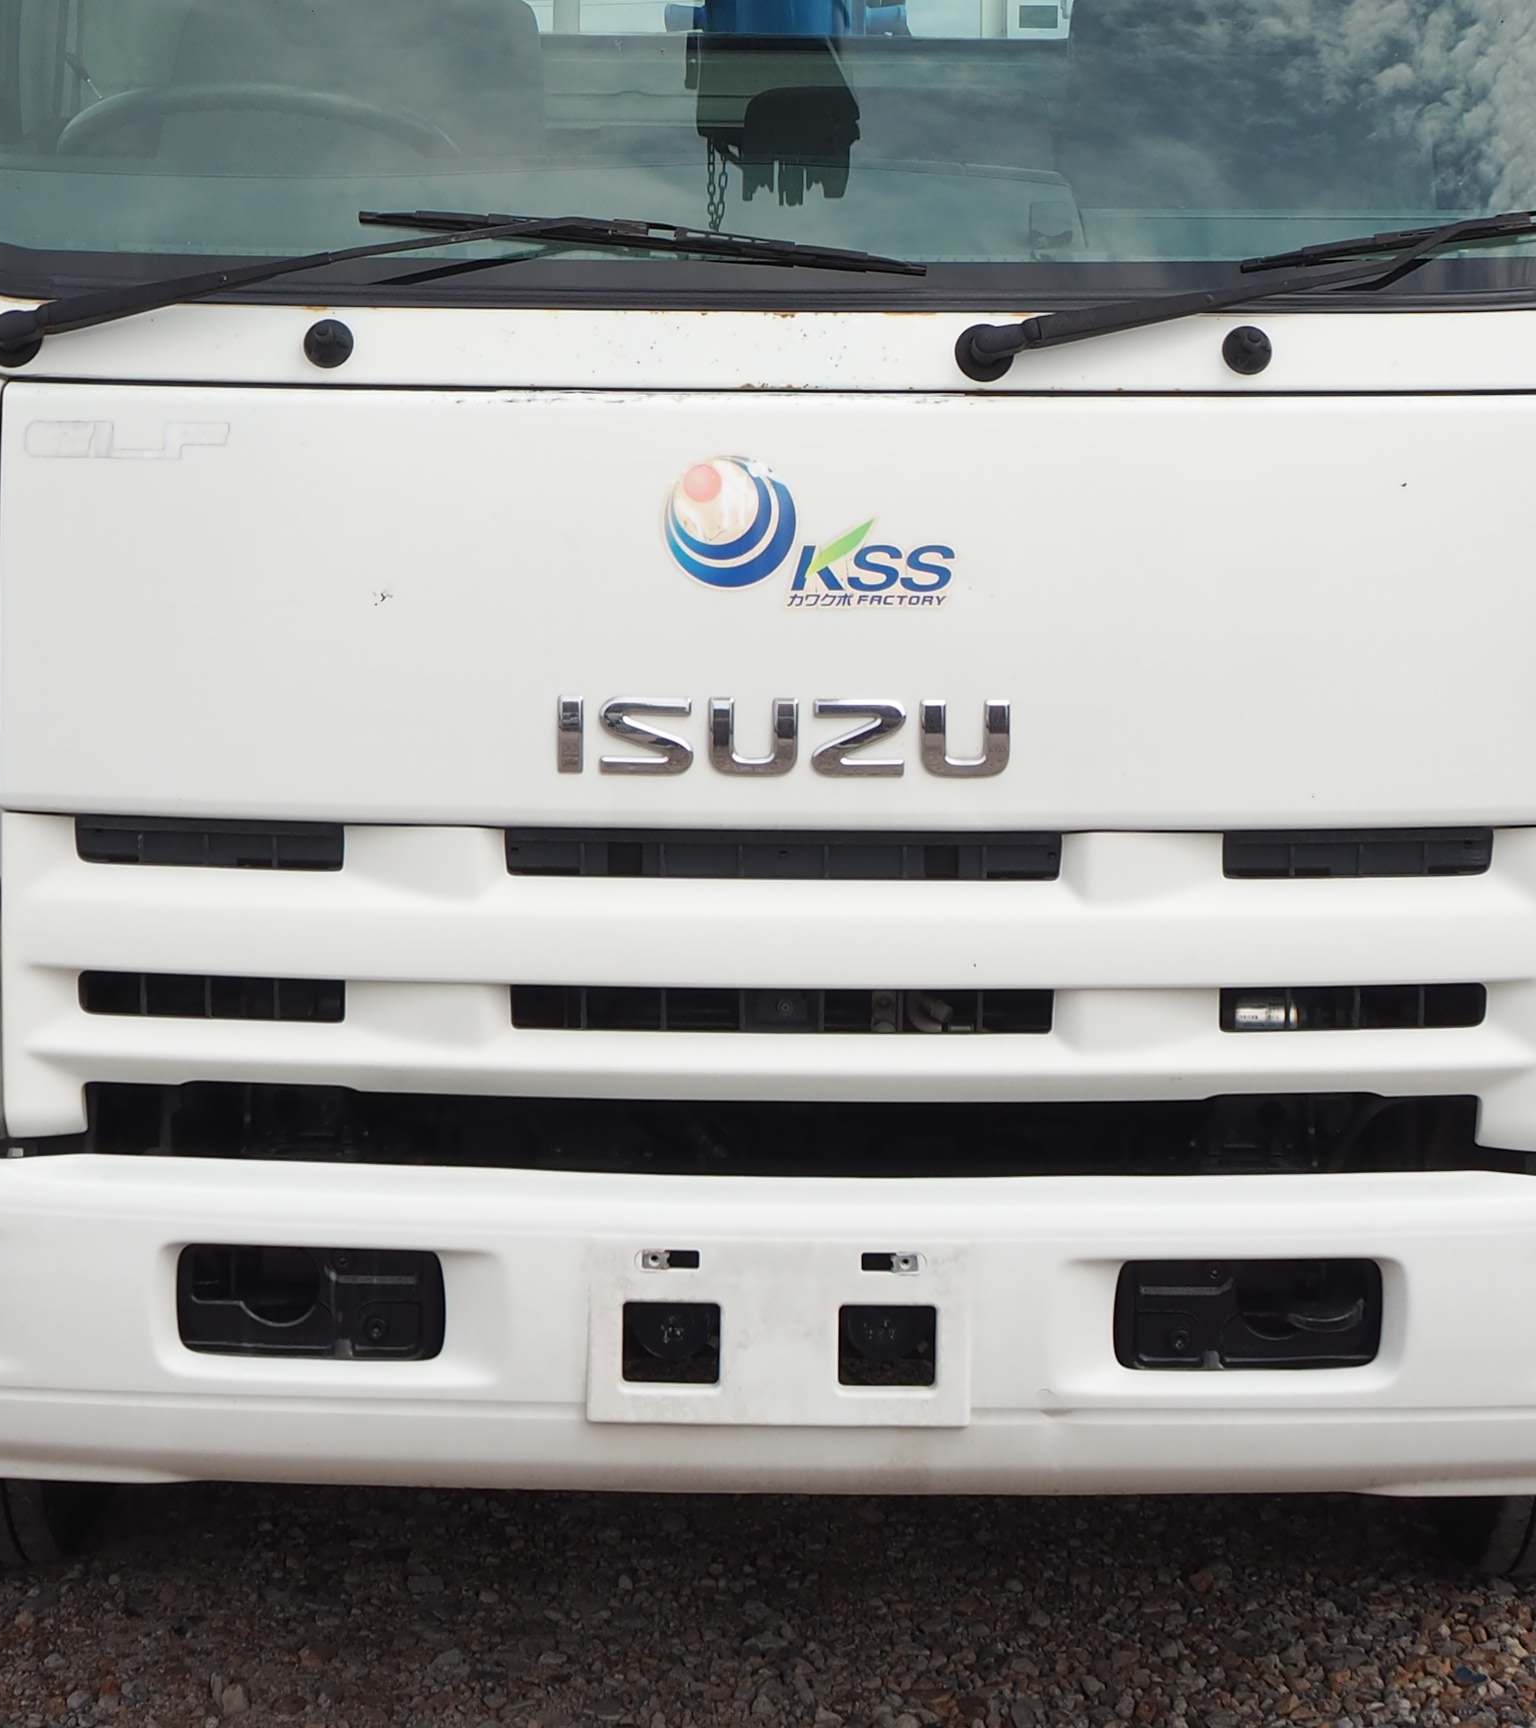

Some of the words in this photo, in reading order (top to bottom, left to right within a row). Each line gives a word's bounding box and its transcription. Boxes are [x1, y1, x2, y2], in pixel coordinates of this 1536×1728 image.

[791, 544, 955, 592] KSS
[787, 593, 854, 606] カワクボ
[857, 595, 947, 606] FACTORY
[556, 694, 1011, 778] ISUZU
